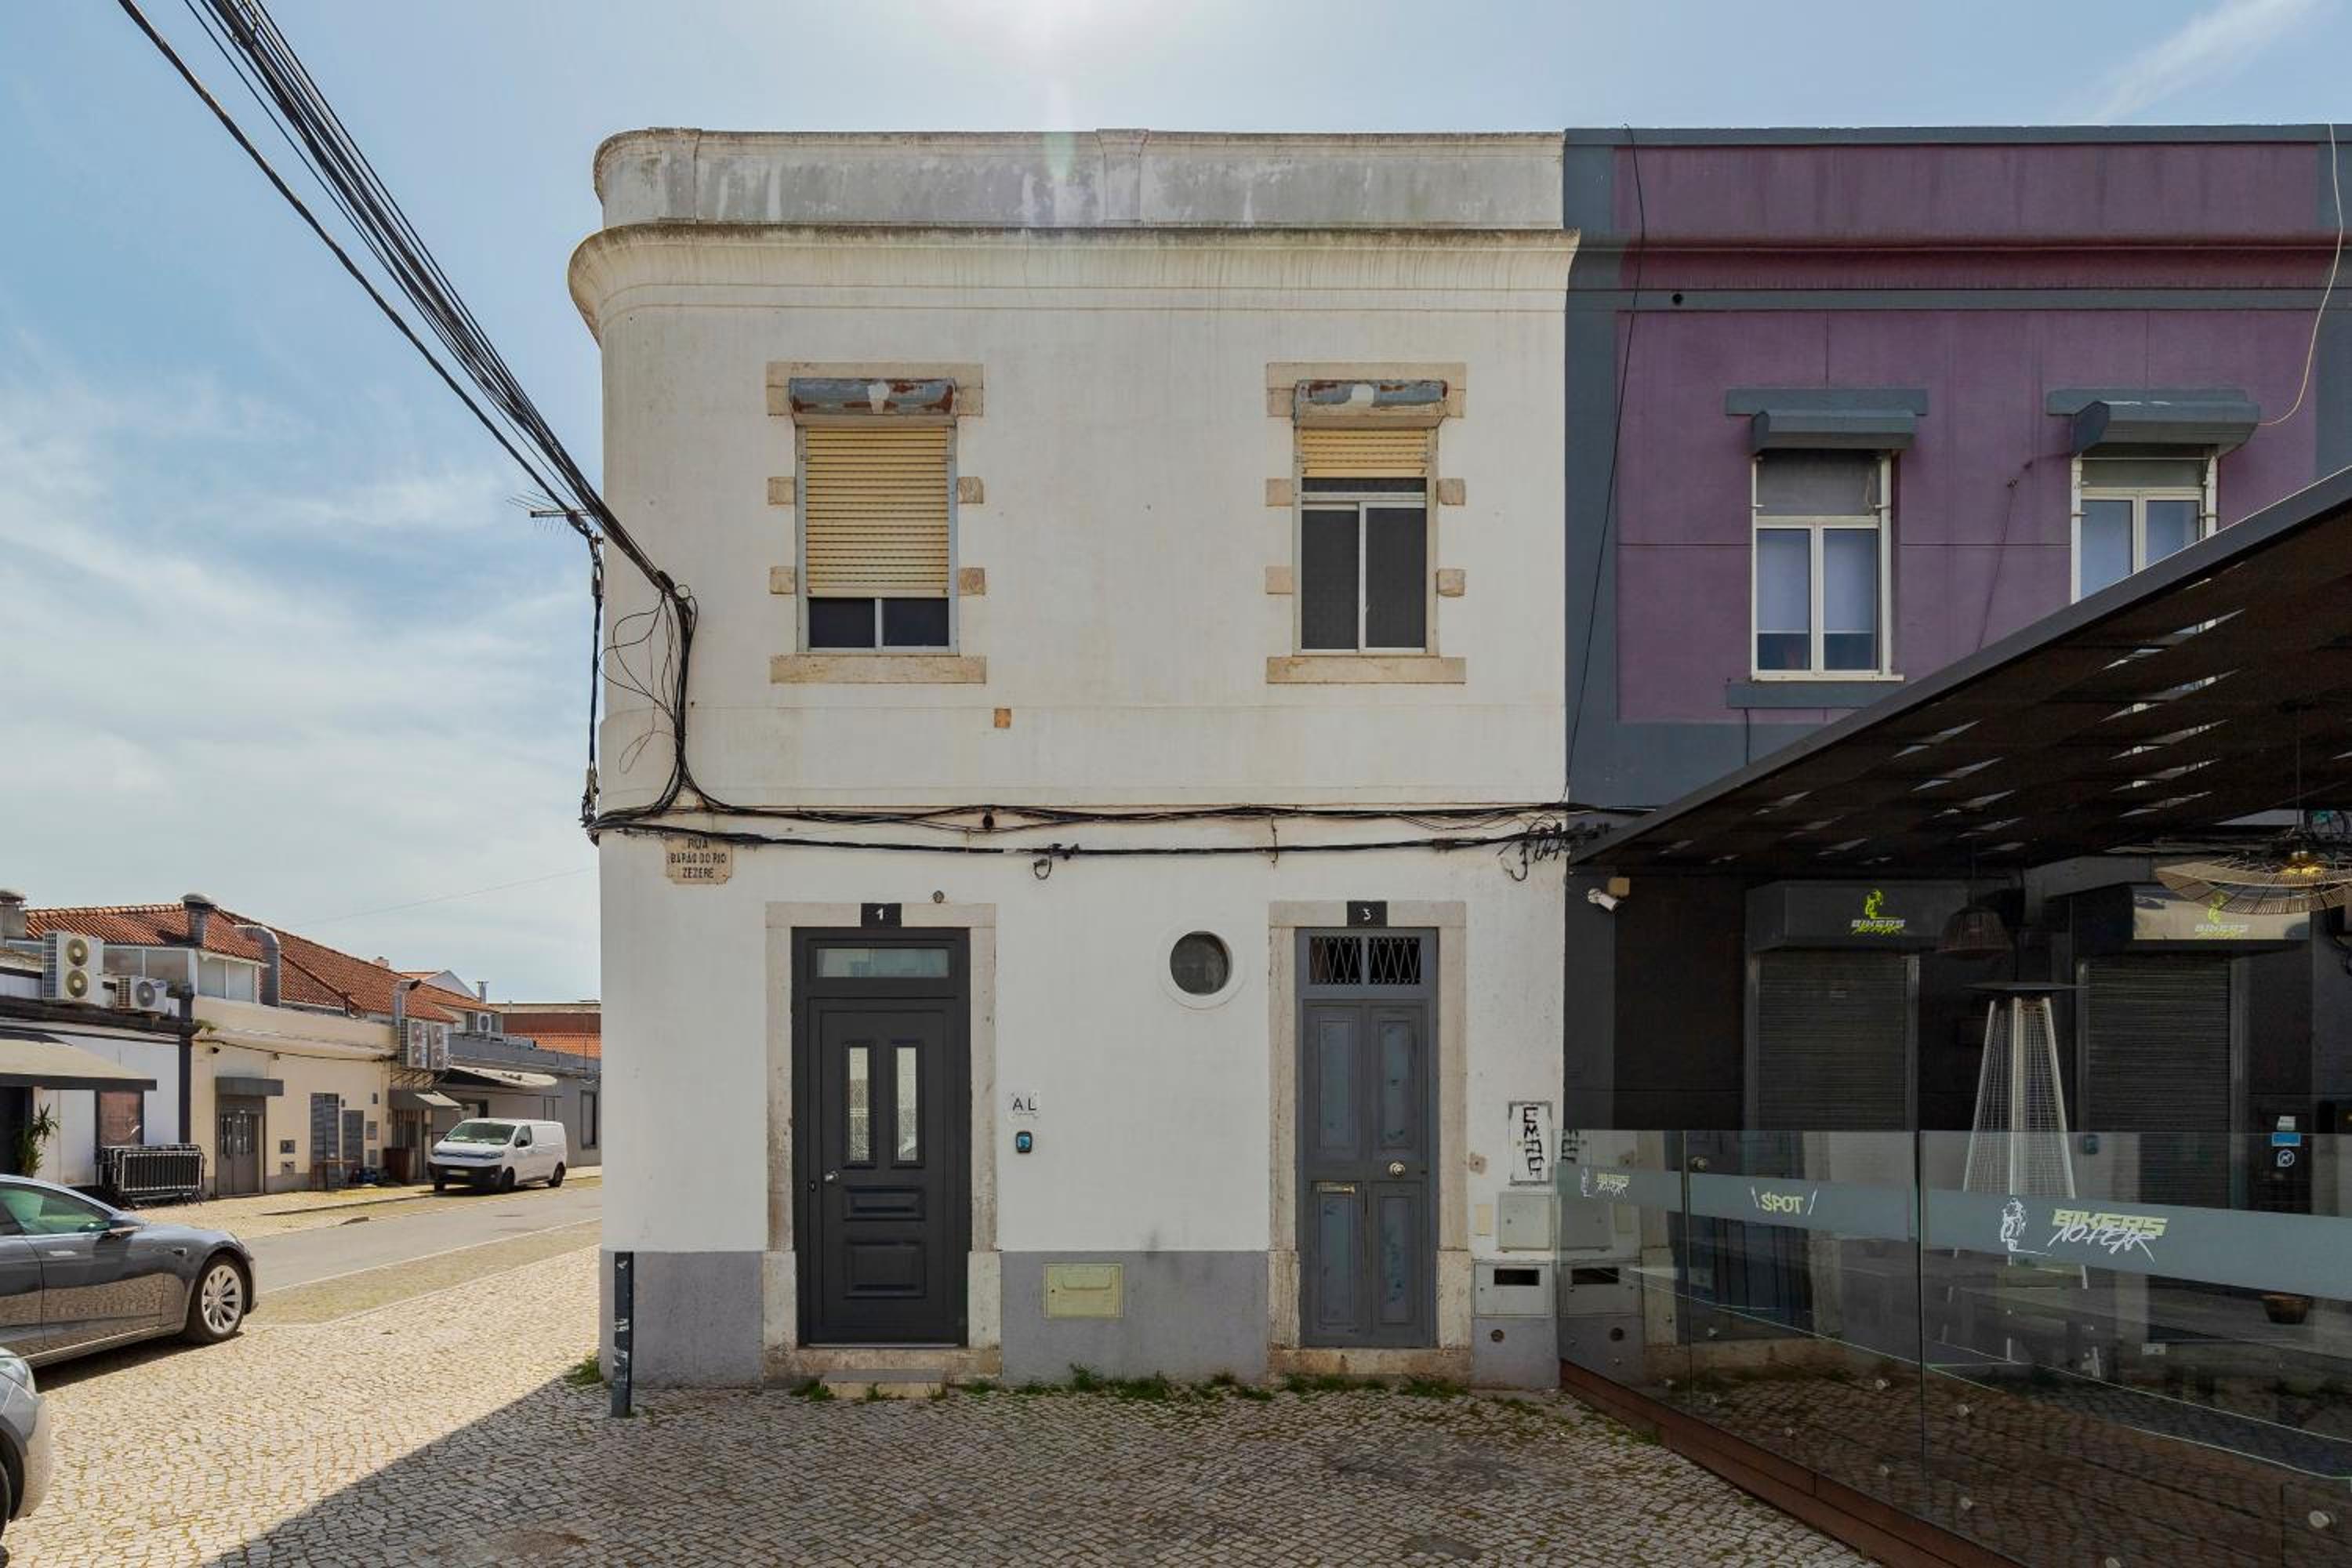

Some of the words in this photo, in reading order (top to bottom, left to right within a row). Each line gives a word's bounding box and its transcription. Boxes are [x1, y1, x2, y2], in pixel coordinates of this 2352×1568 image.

[699, 852, 711, 863] DO
[876, 908, 884, 921] 1
[1363, 908, 1371, 920] 3
[1761, 1192, 1804, 1214] SPOT
[2052, 1208, 2168, 1236] BIKERS
